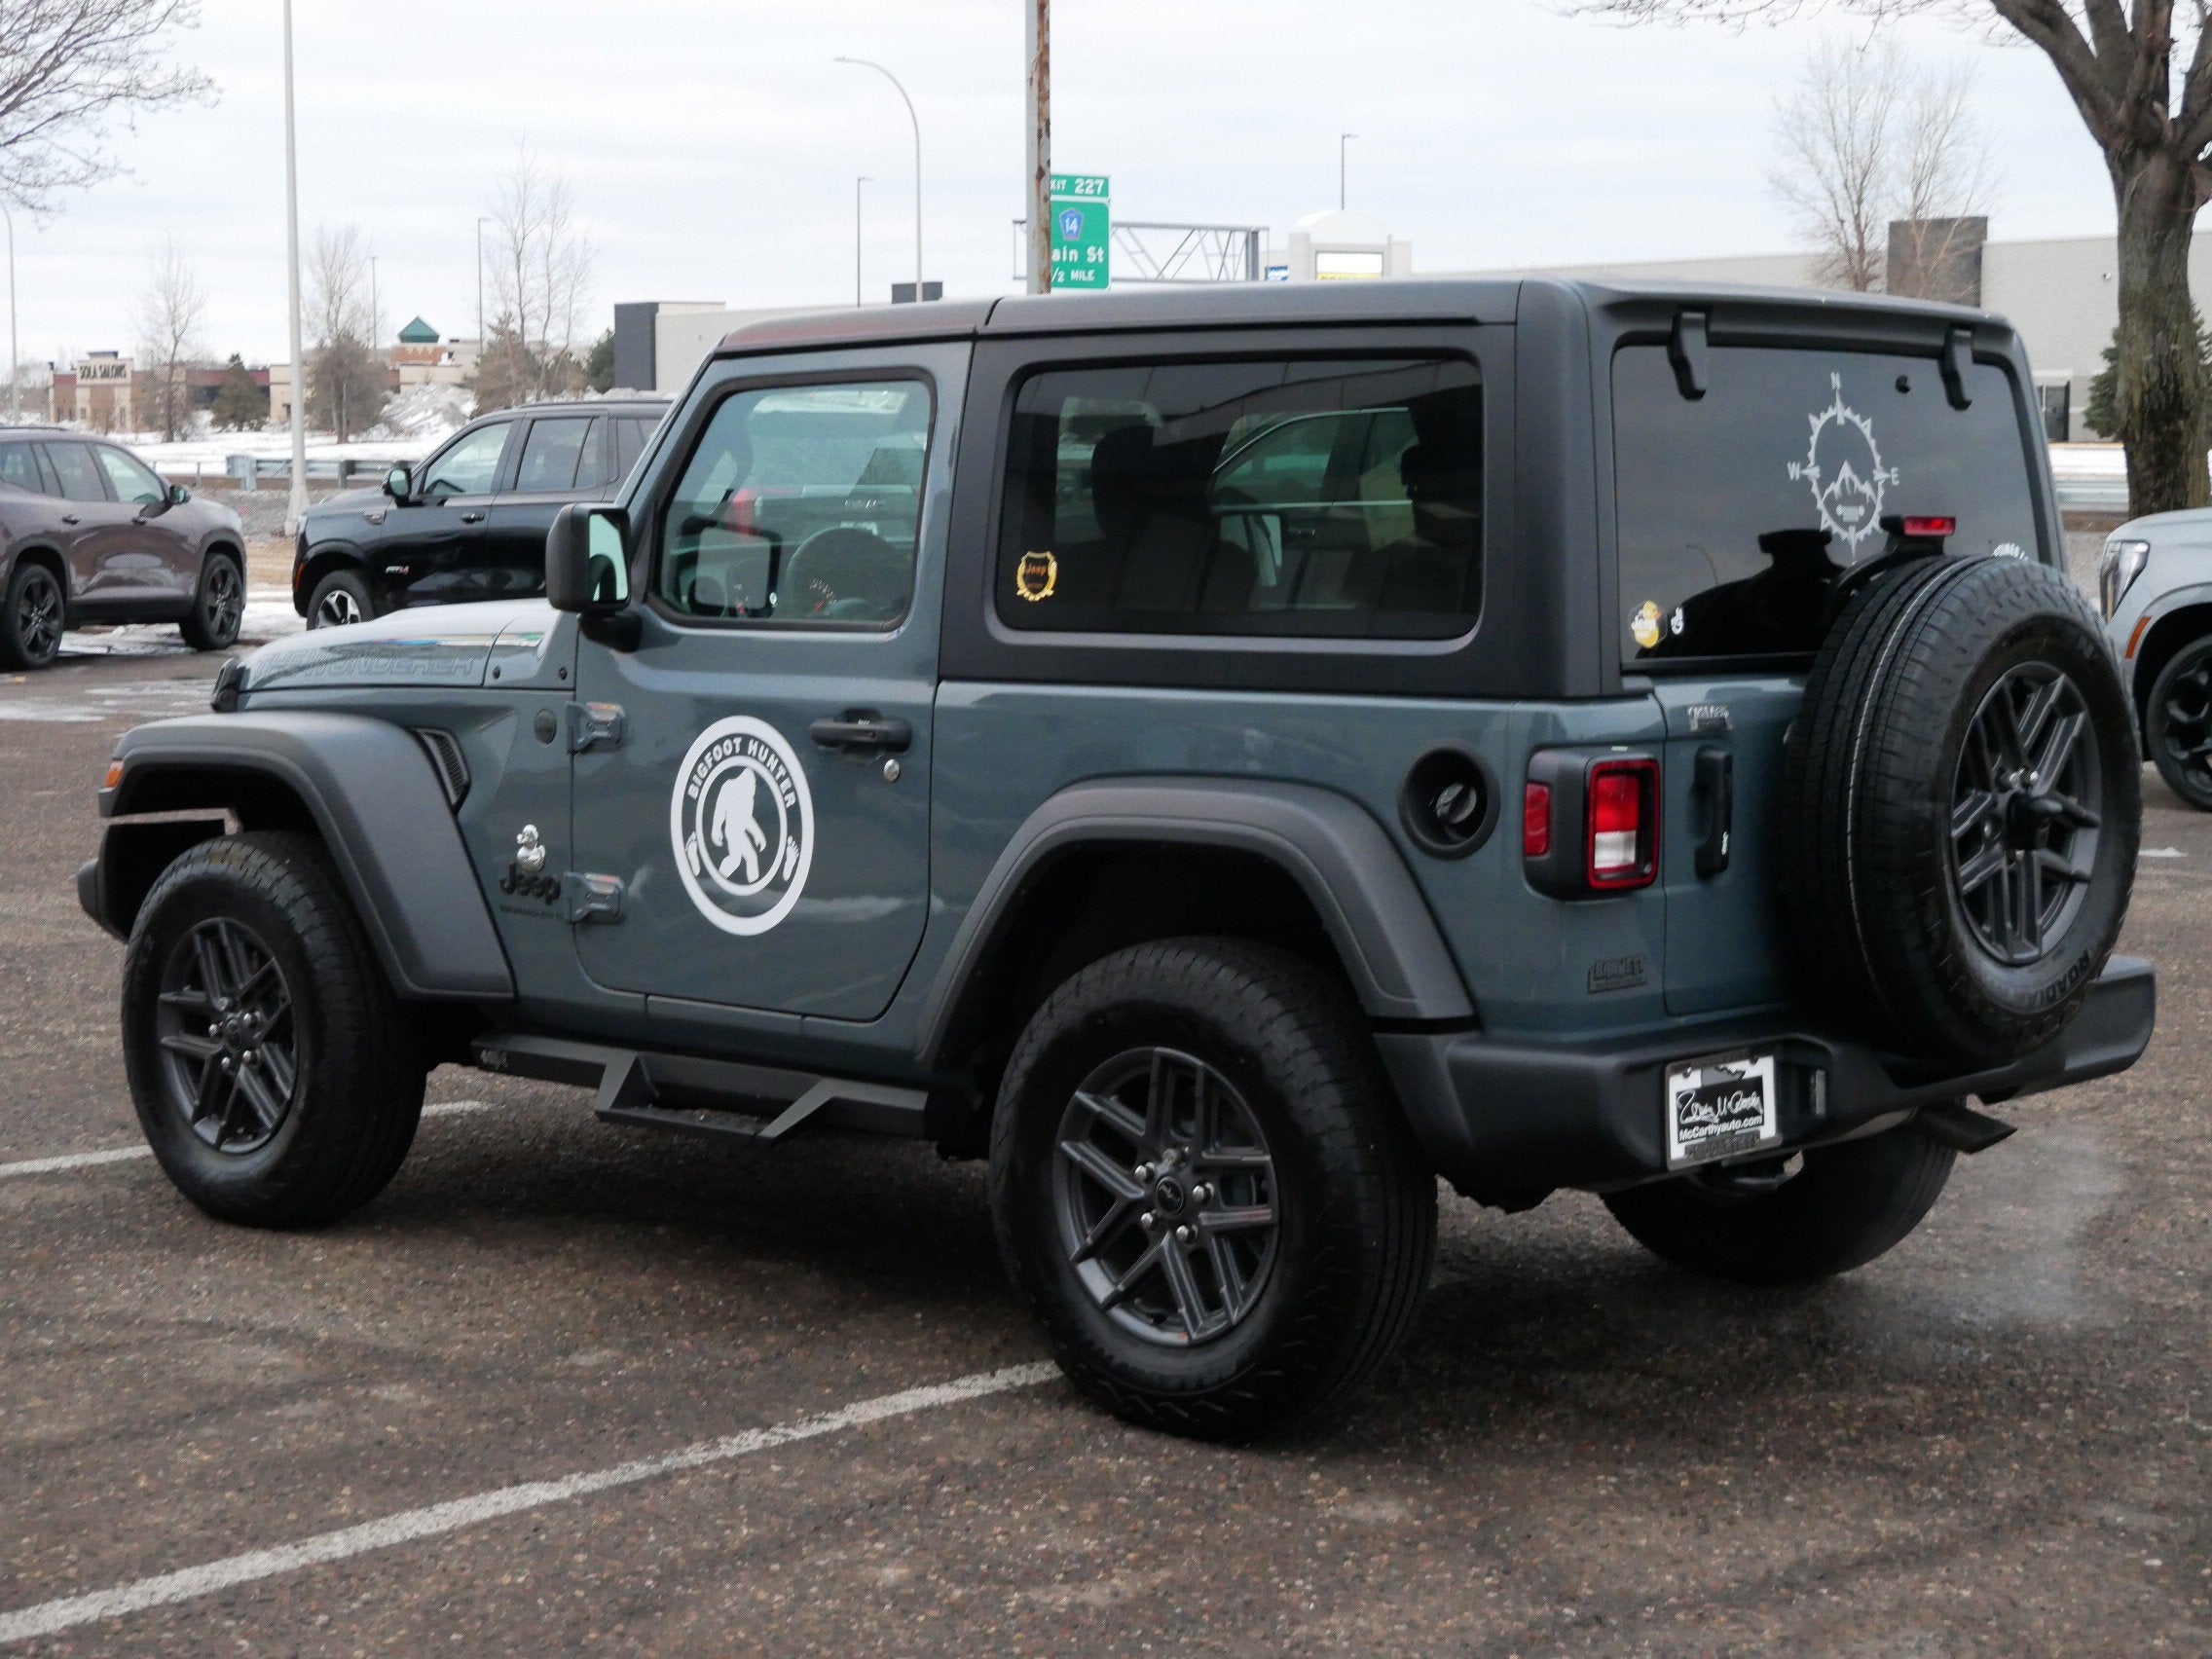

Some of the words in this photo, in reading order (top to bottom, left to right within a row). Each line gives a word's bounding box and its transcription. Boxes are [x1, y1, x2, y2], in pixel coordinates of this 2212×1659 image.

[1051, 179, 1067, 191] XIT
[1074, 178, 1105, 195] 227
[1051, 245, 1079, 262] ain
[1087, 245, 1105, 264] St
[1051, 267, 1065, 283] /2
[1071, 269, 1095, 282] MILE
[1830, 371, 1841, 389] N
[1787, 461, 1801, 481] W
[1890, 467, 1899, 486] E
[686, 737, 743, 799] BIGFOOT
[748, 738, 797, 808] HUNTER
